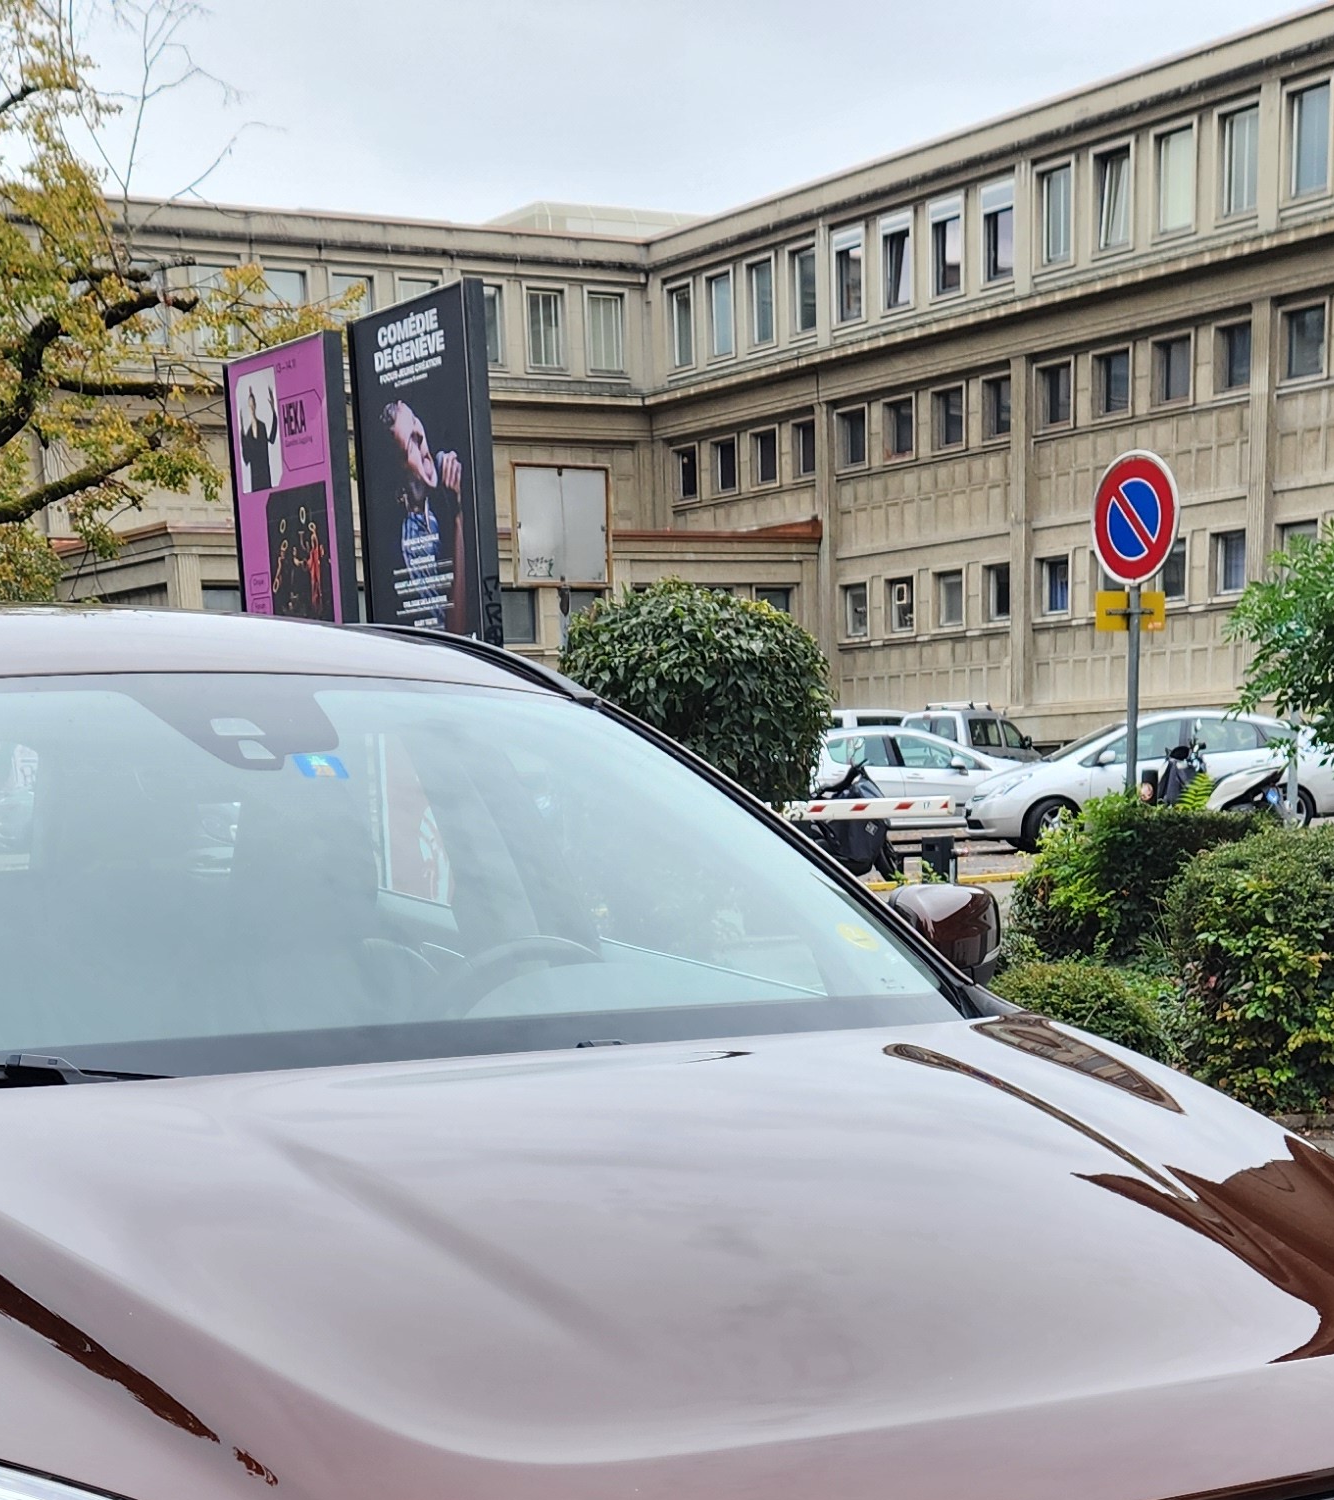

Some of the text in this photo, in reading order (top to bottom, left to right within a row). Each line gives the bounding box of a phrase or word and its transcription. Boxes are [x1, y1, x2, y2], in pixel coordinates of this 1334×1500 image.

[377, 307, 438, 348] COMÉDIE
[373, 329, 445, 373] DE GENÈVE
